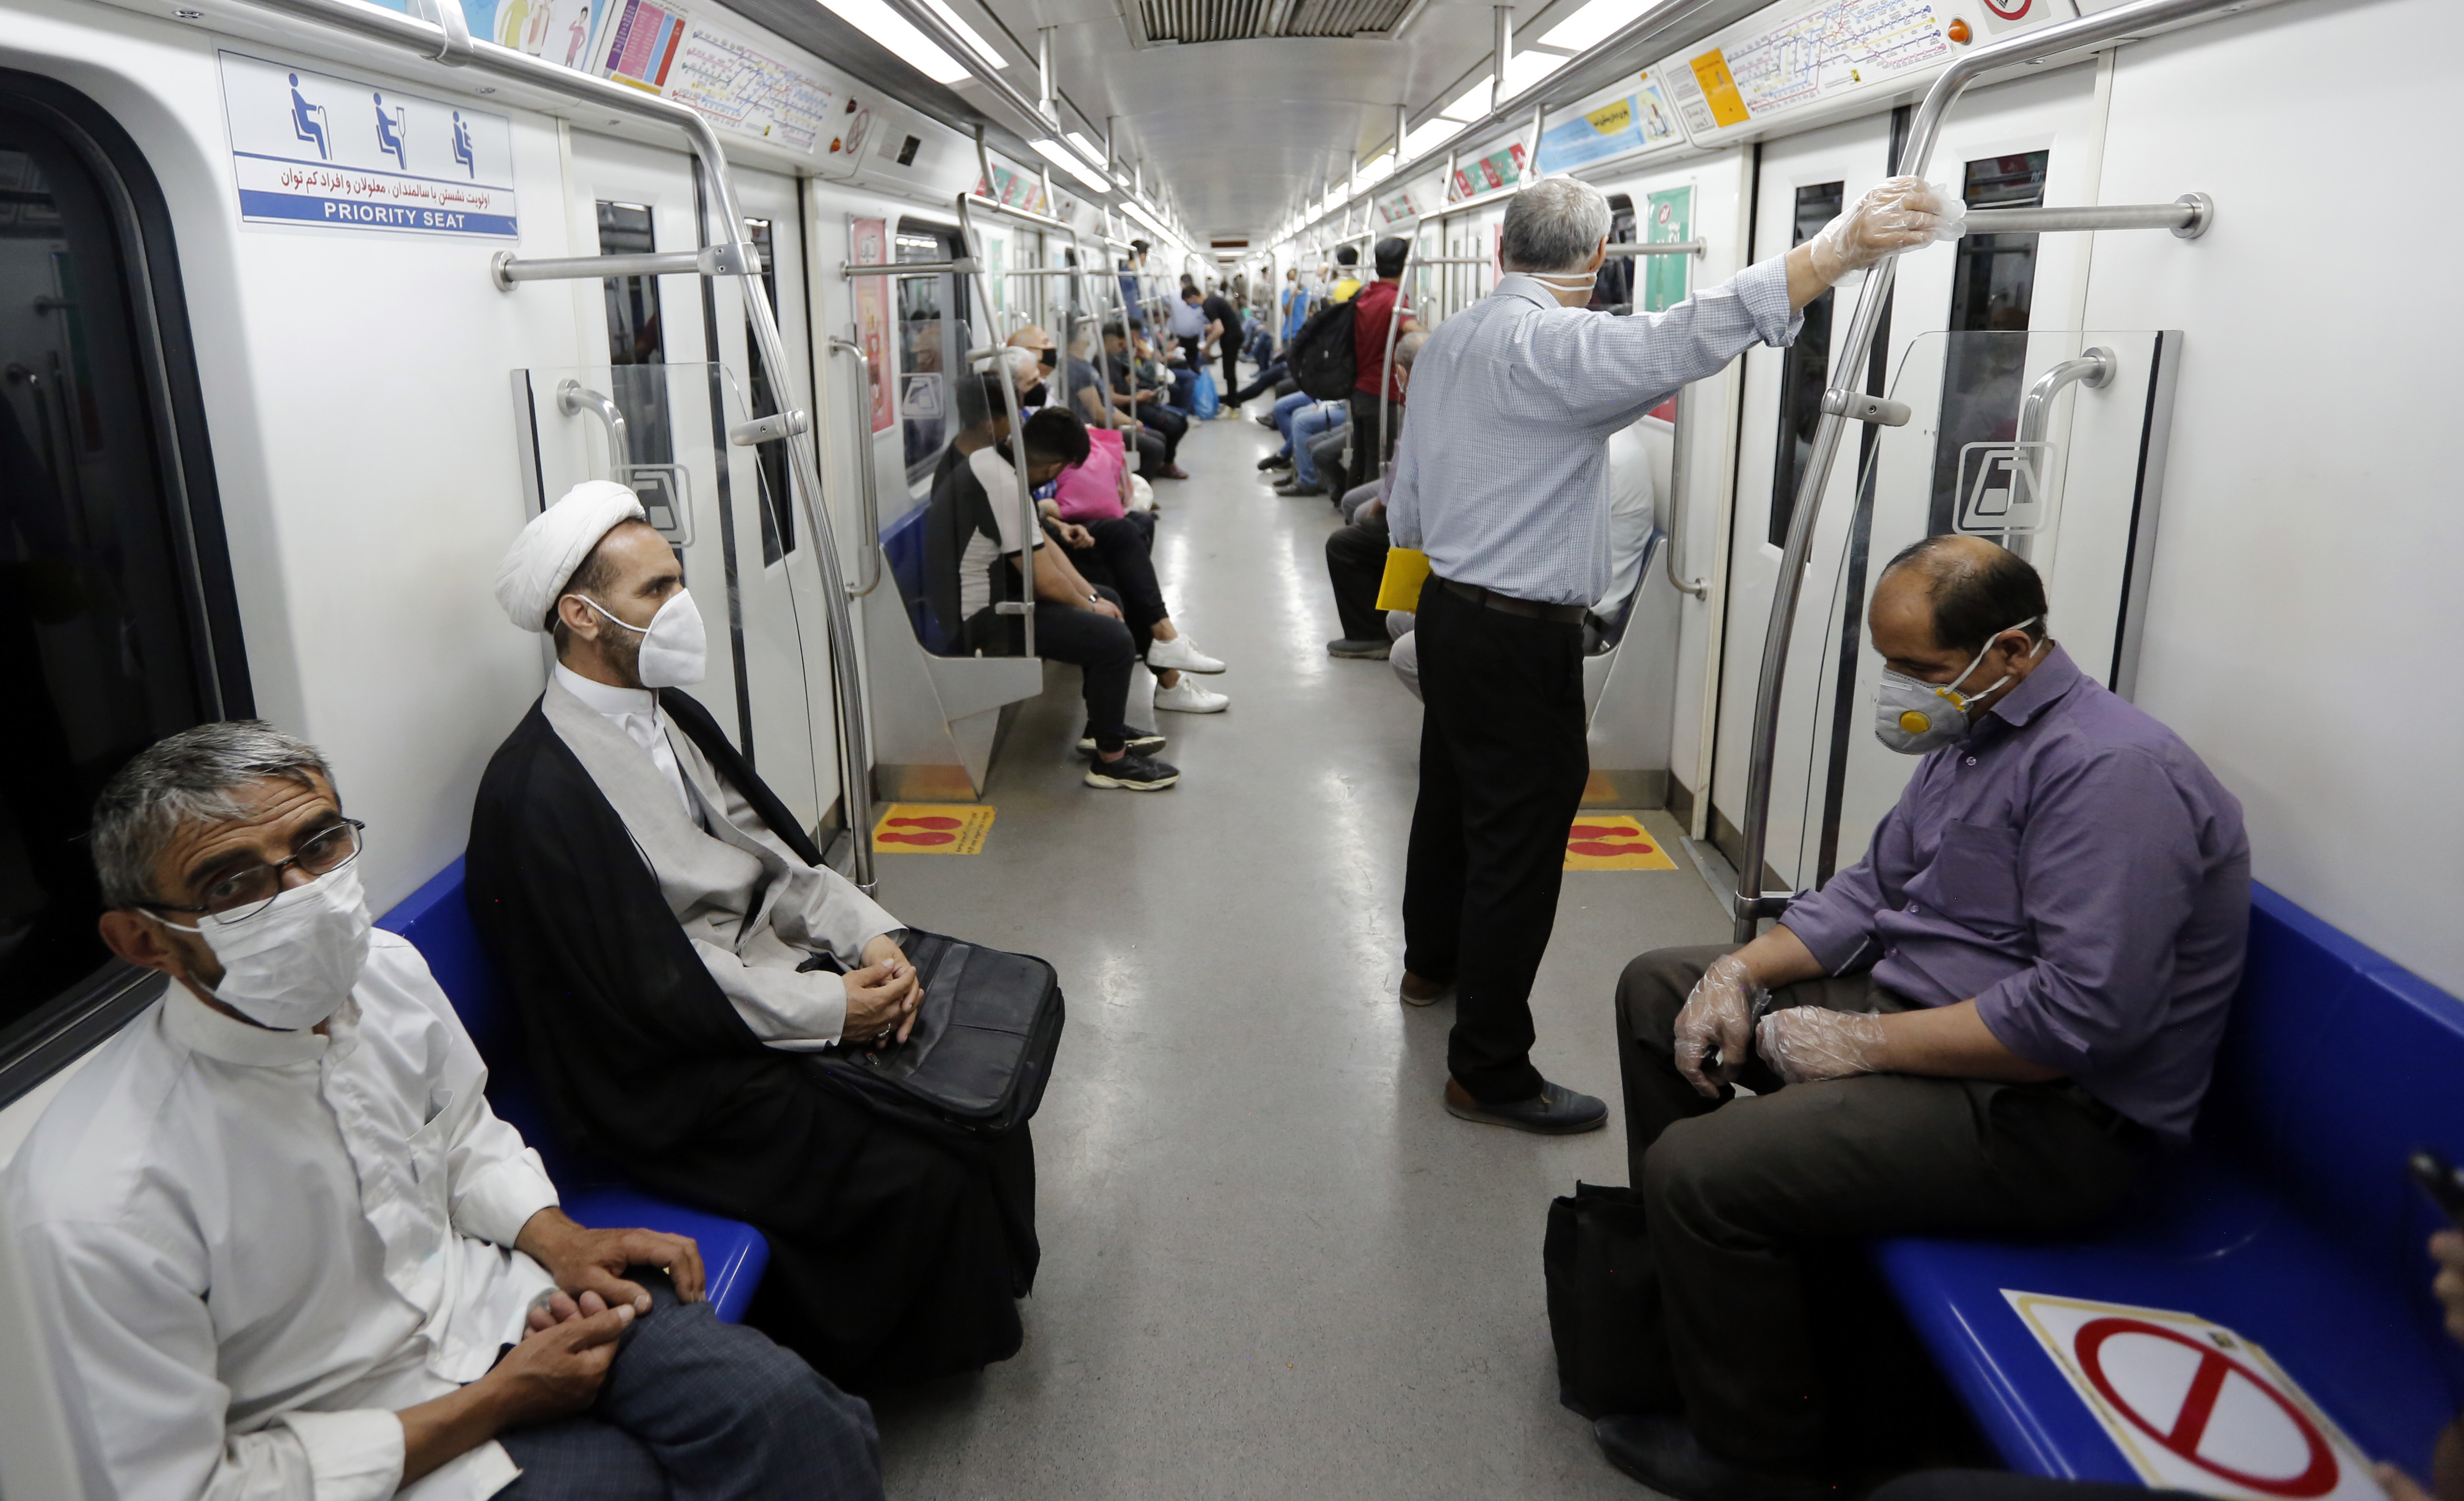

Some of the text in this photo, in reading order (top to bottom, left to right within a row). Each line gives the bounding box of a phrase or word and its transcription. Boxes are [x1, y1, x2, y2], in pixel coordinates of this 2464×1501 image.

[281, 168, 304, 190] توان
[306, 171, 318, 193] کم
[320, 172, 344, 192] افراد
[346, 180, 351, 194] و
[353, 177, 386, 198] معلولان
[430, 186, 437, 203] با
[439, 189, 465, 205] نشستن
[466, 192, 490, 209] اولویت
[324, 201, 465, 229] PRIORITY SEAT
